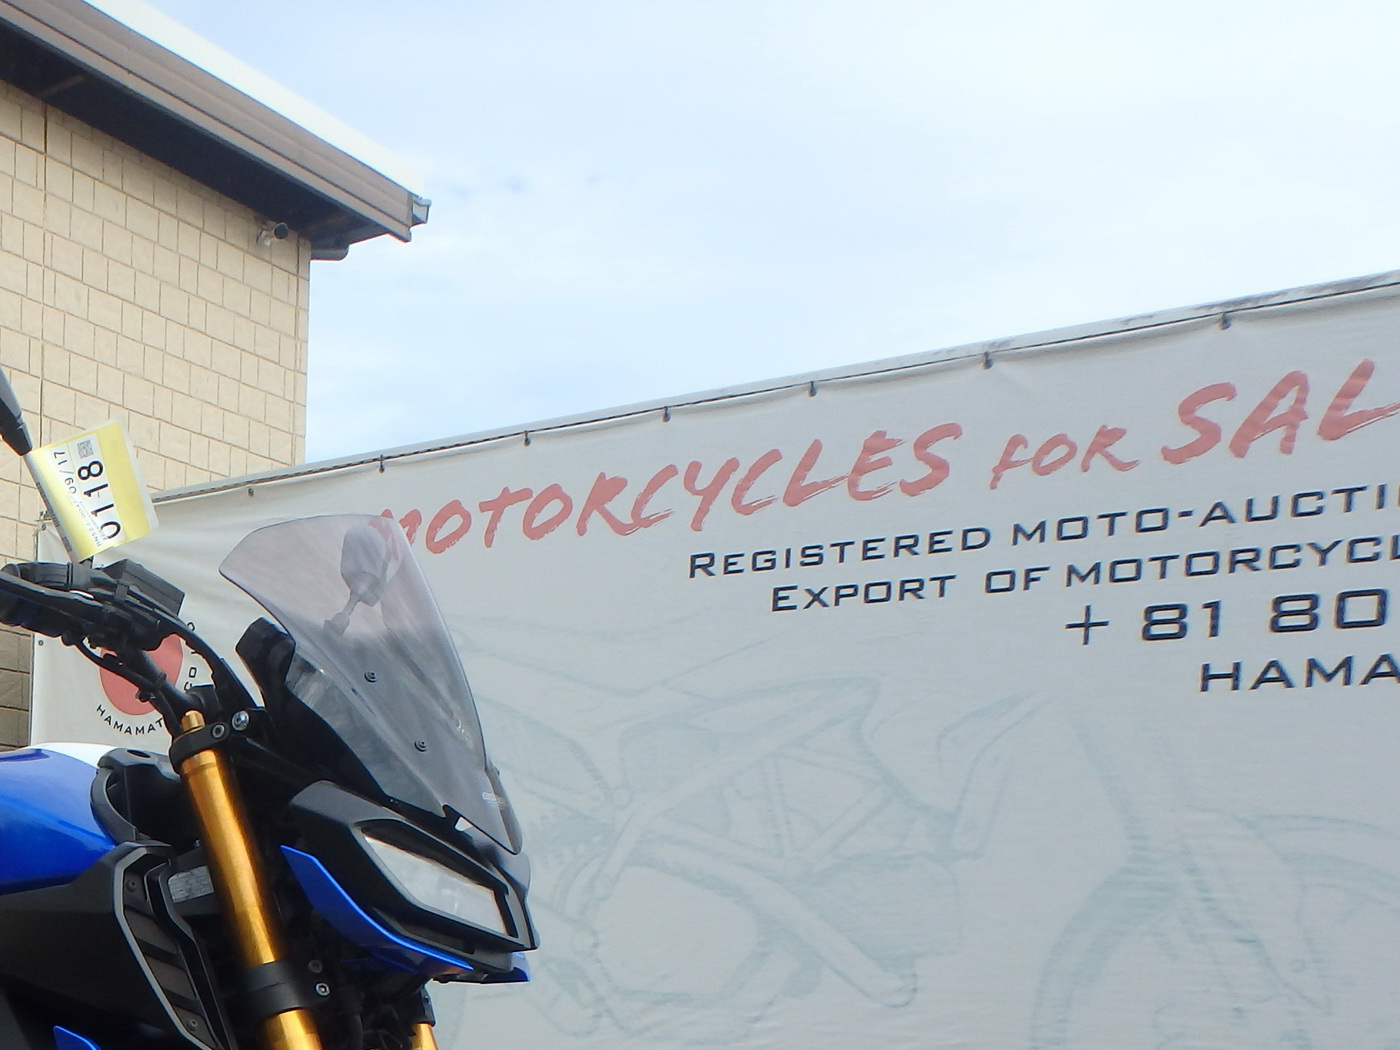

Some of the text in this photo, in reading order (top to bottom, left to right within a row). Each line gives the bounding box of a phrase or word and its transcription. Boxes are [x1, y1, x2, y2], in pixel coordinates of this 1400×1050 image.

[53, 451, 77, 494] 09/17
[368, 422, 963, 557] MOTORCYCLES
[1161, 359, 1400, 465] SAL
[77, 460, 122, 540] 0118
[689, 483, 1400, 579] REGISTERED MOTO-AUCTI
[771, 574, 957, 612] EXPORT
[985, 567, 1050, 595] OF
[1141, 599, 1221, 642] 81
[1269, 588, 1388, 634] 80
[1198, 653, 1400, 692] HAMA
